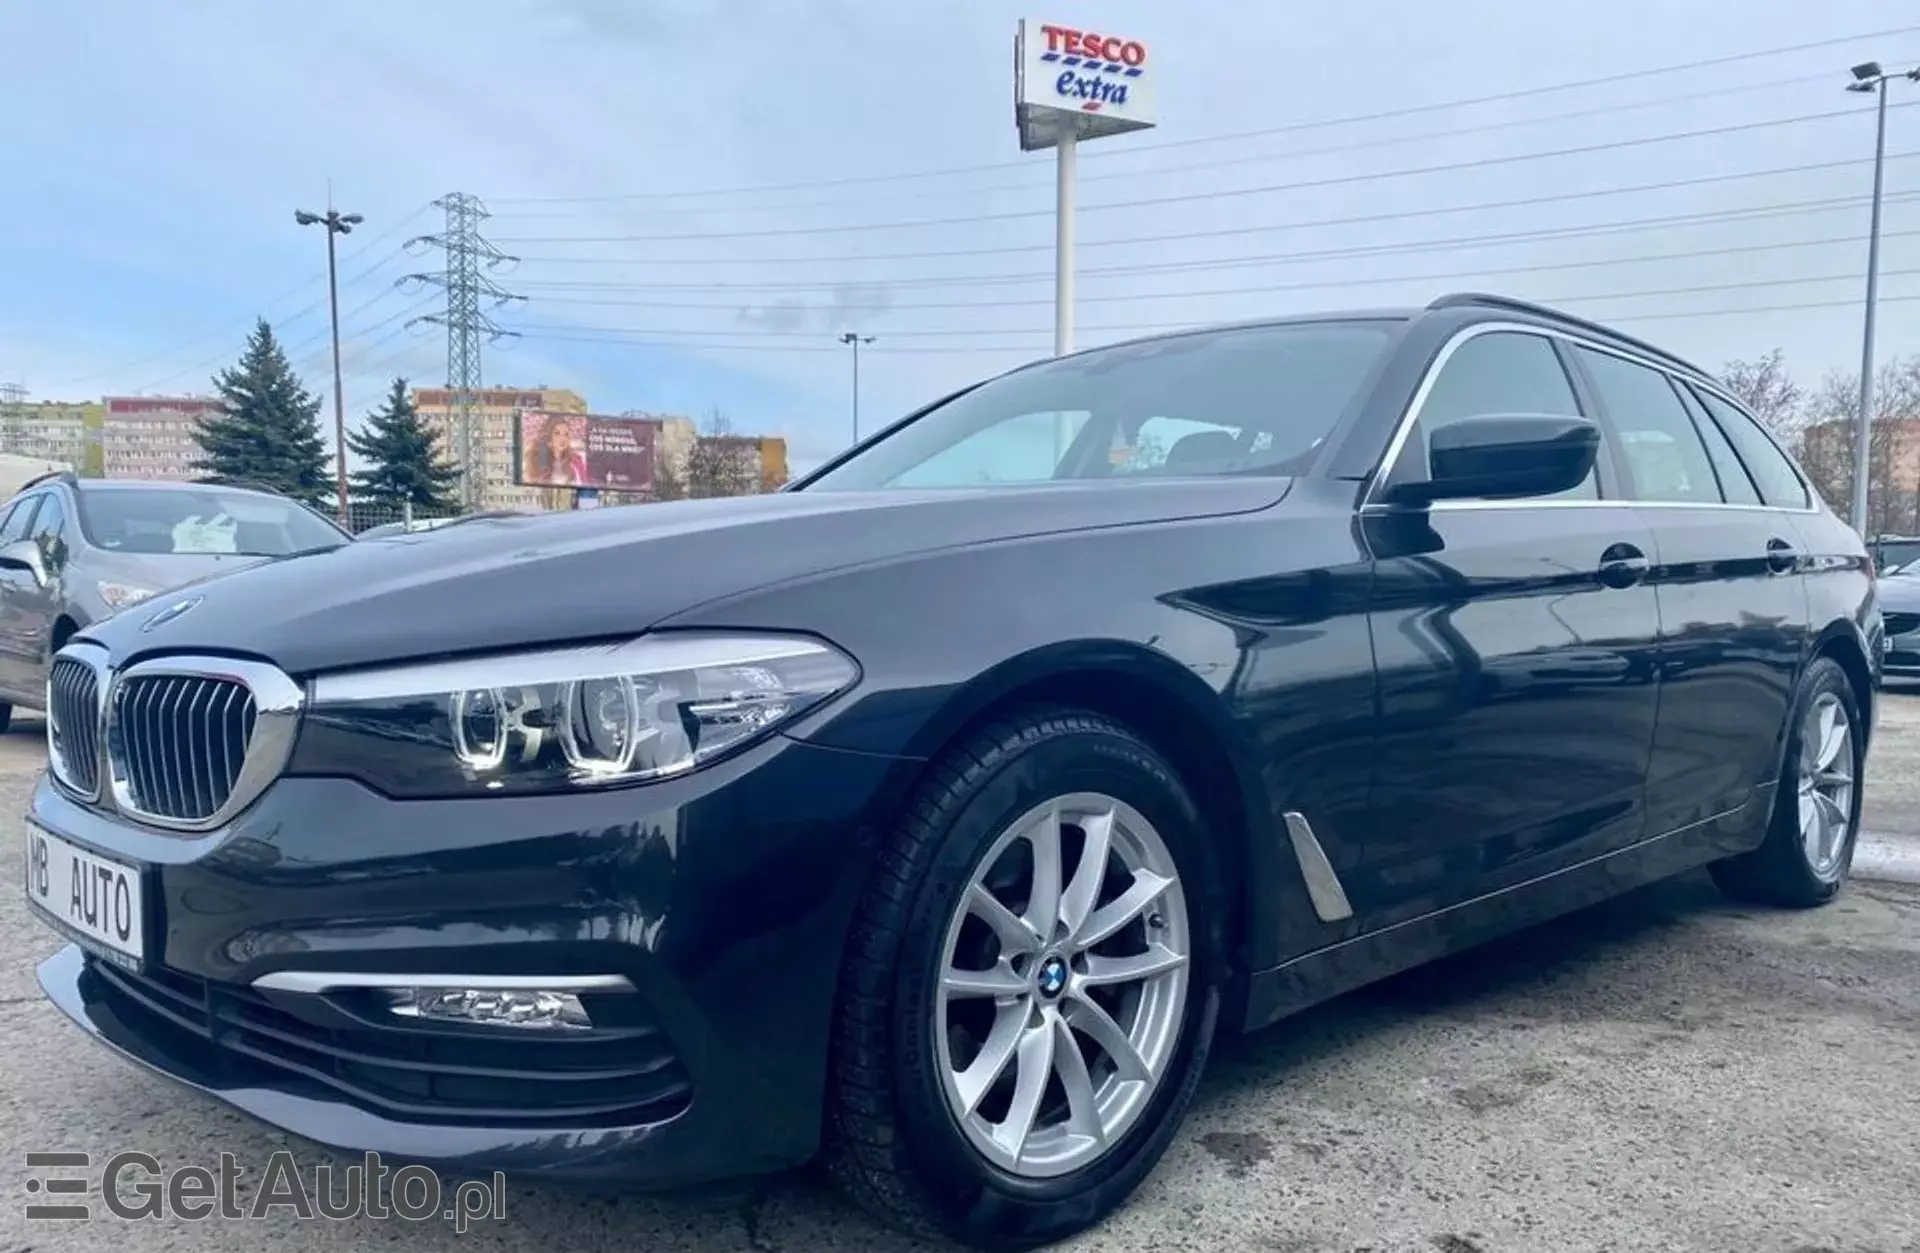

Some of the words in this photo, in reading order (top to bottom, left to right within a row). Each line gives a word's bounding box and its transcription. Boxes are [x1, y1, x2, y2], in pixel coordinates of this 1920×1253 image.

[1041, 25, 1145, 66] TESCO
[1056, 70, 1128, 104] extra
[71, 857, 131, 942] AUTO
